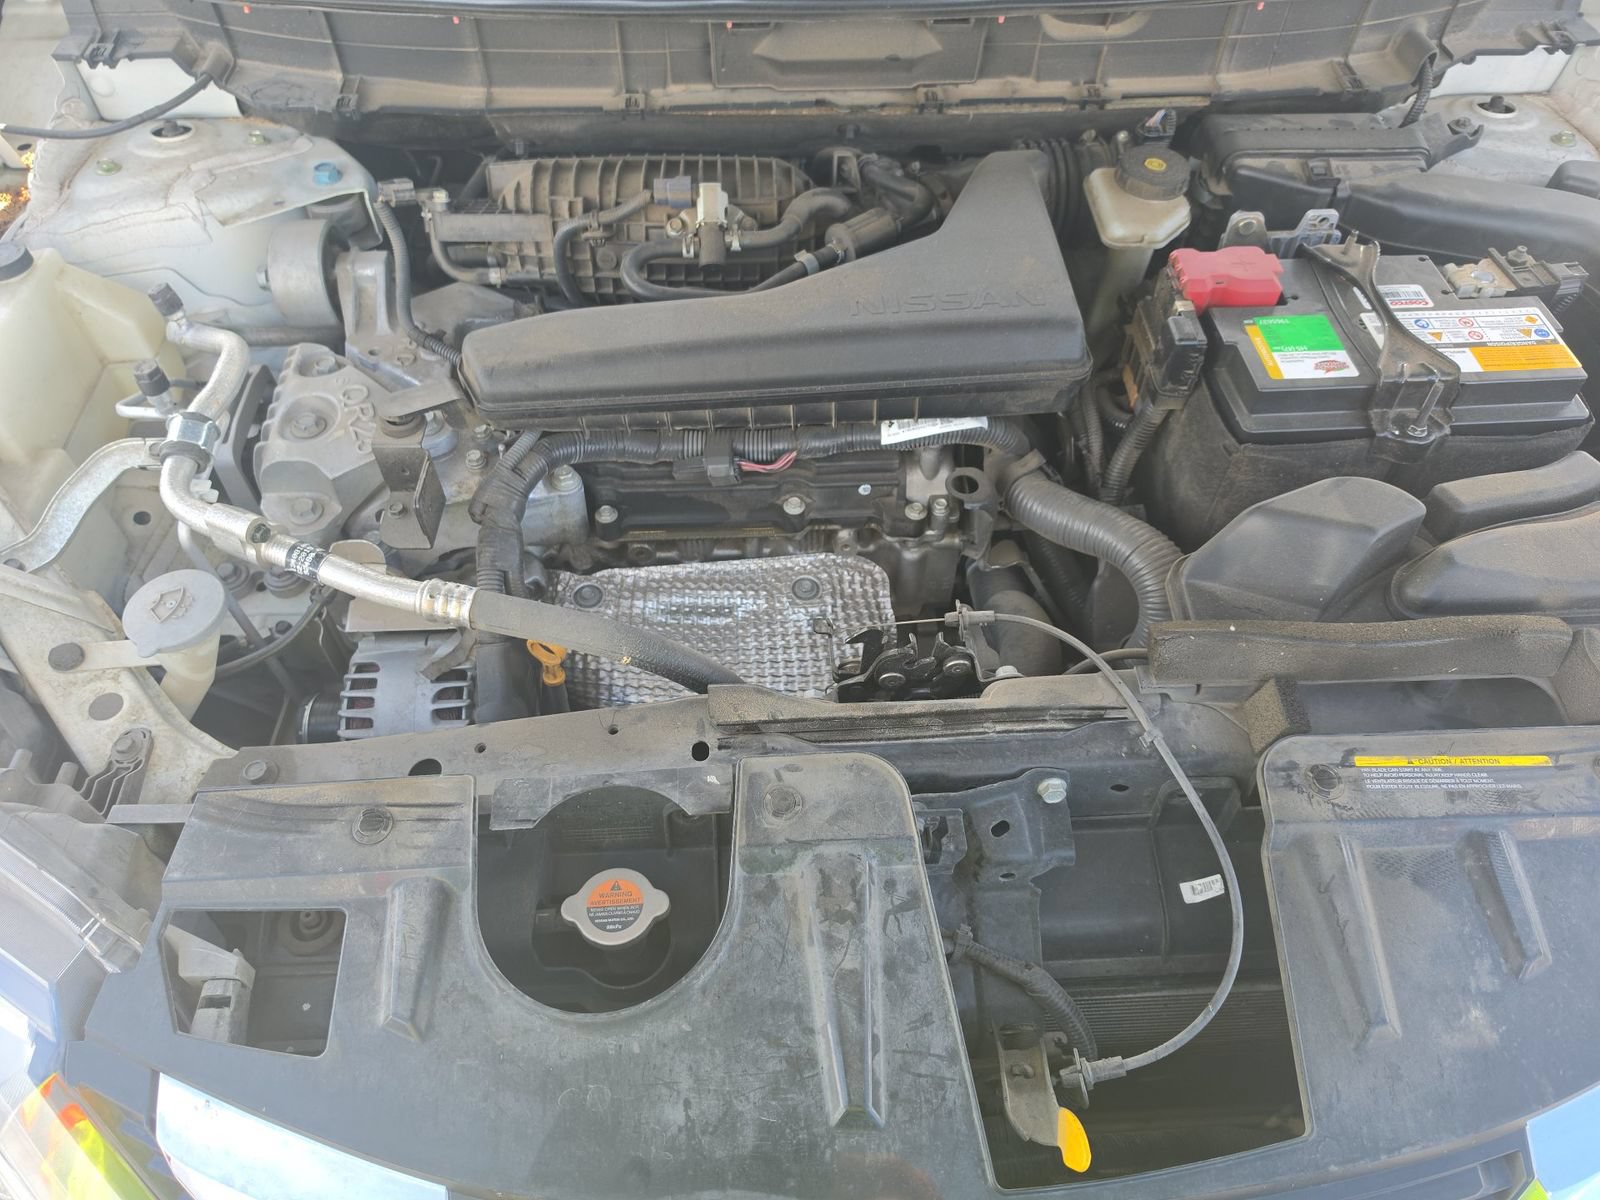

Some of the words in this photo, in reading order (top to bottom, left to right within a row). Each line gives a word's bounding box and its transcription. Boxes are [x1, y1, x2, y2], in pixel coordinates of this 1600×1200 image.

[850, 289, 1047, 317] NISSAN
[1418, 757, 1452, 765] CAUTION
[1459, 757, 1500, 765] ATTENTION
